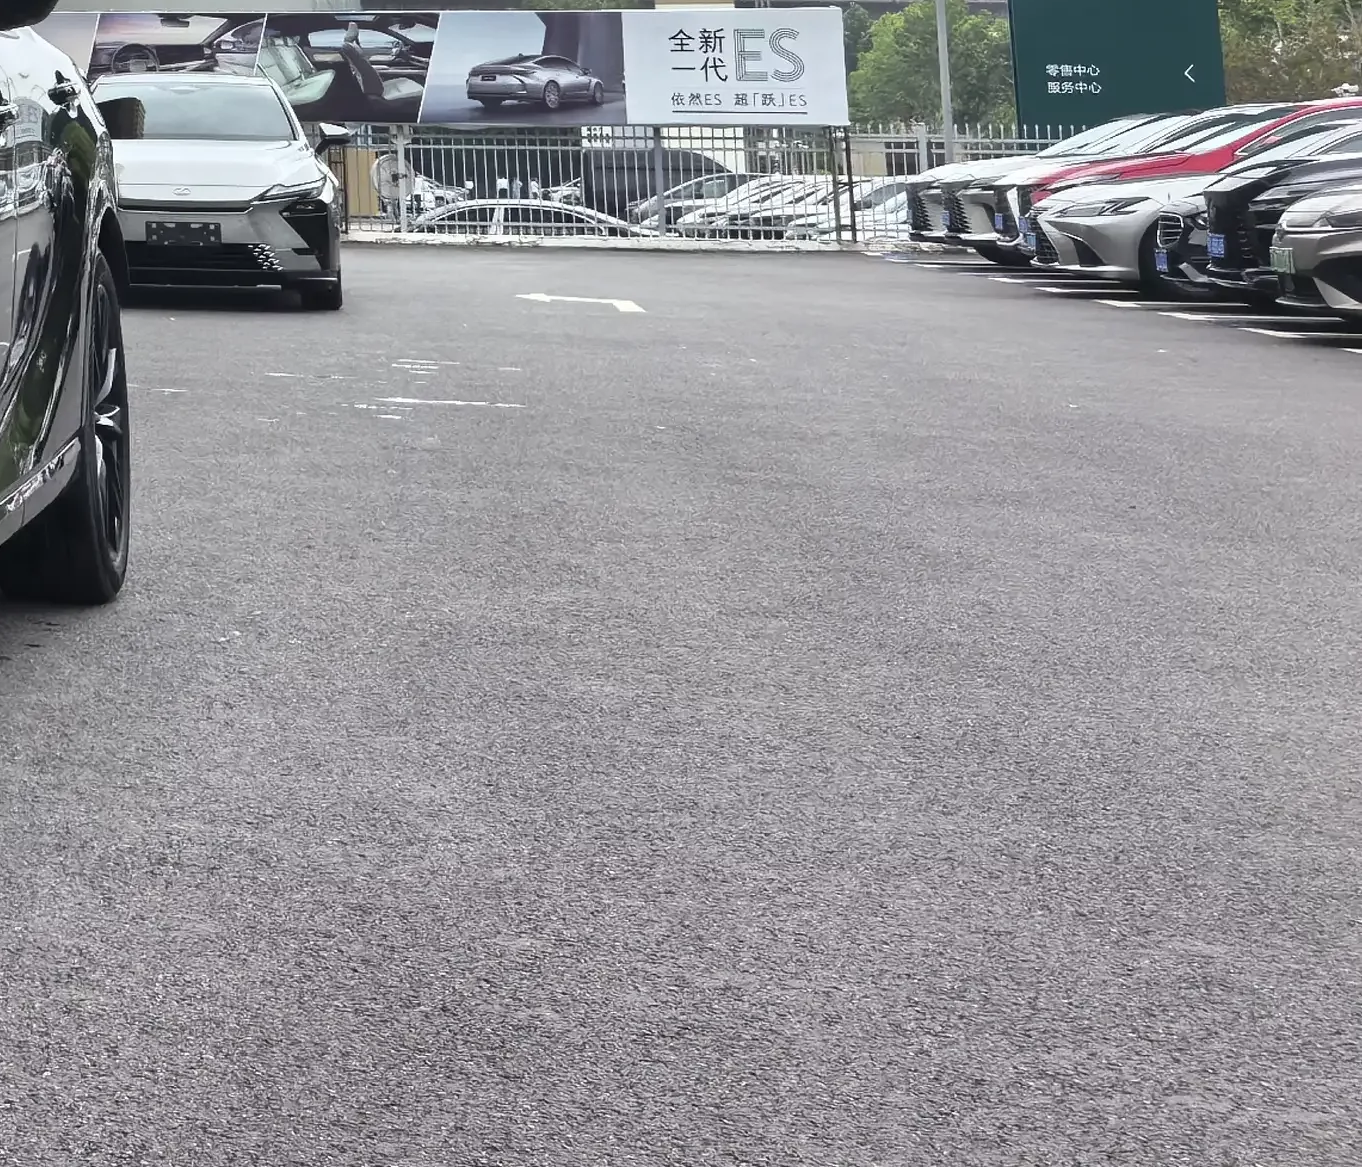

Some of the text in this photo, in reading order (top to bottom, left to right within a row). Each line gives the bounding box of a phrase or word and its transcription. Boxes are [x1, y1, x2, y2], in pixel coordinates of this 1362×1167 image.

[668, 28, 726, 54] 全新
[733, 27, 805, 82] ES
[671, 56, 728, 83] 一代
[1045, 63, 1101, 76] 零售中心
[1047, 81, 1102, 94] 服务中心
[671, 92, 722, 107] 依然ES
